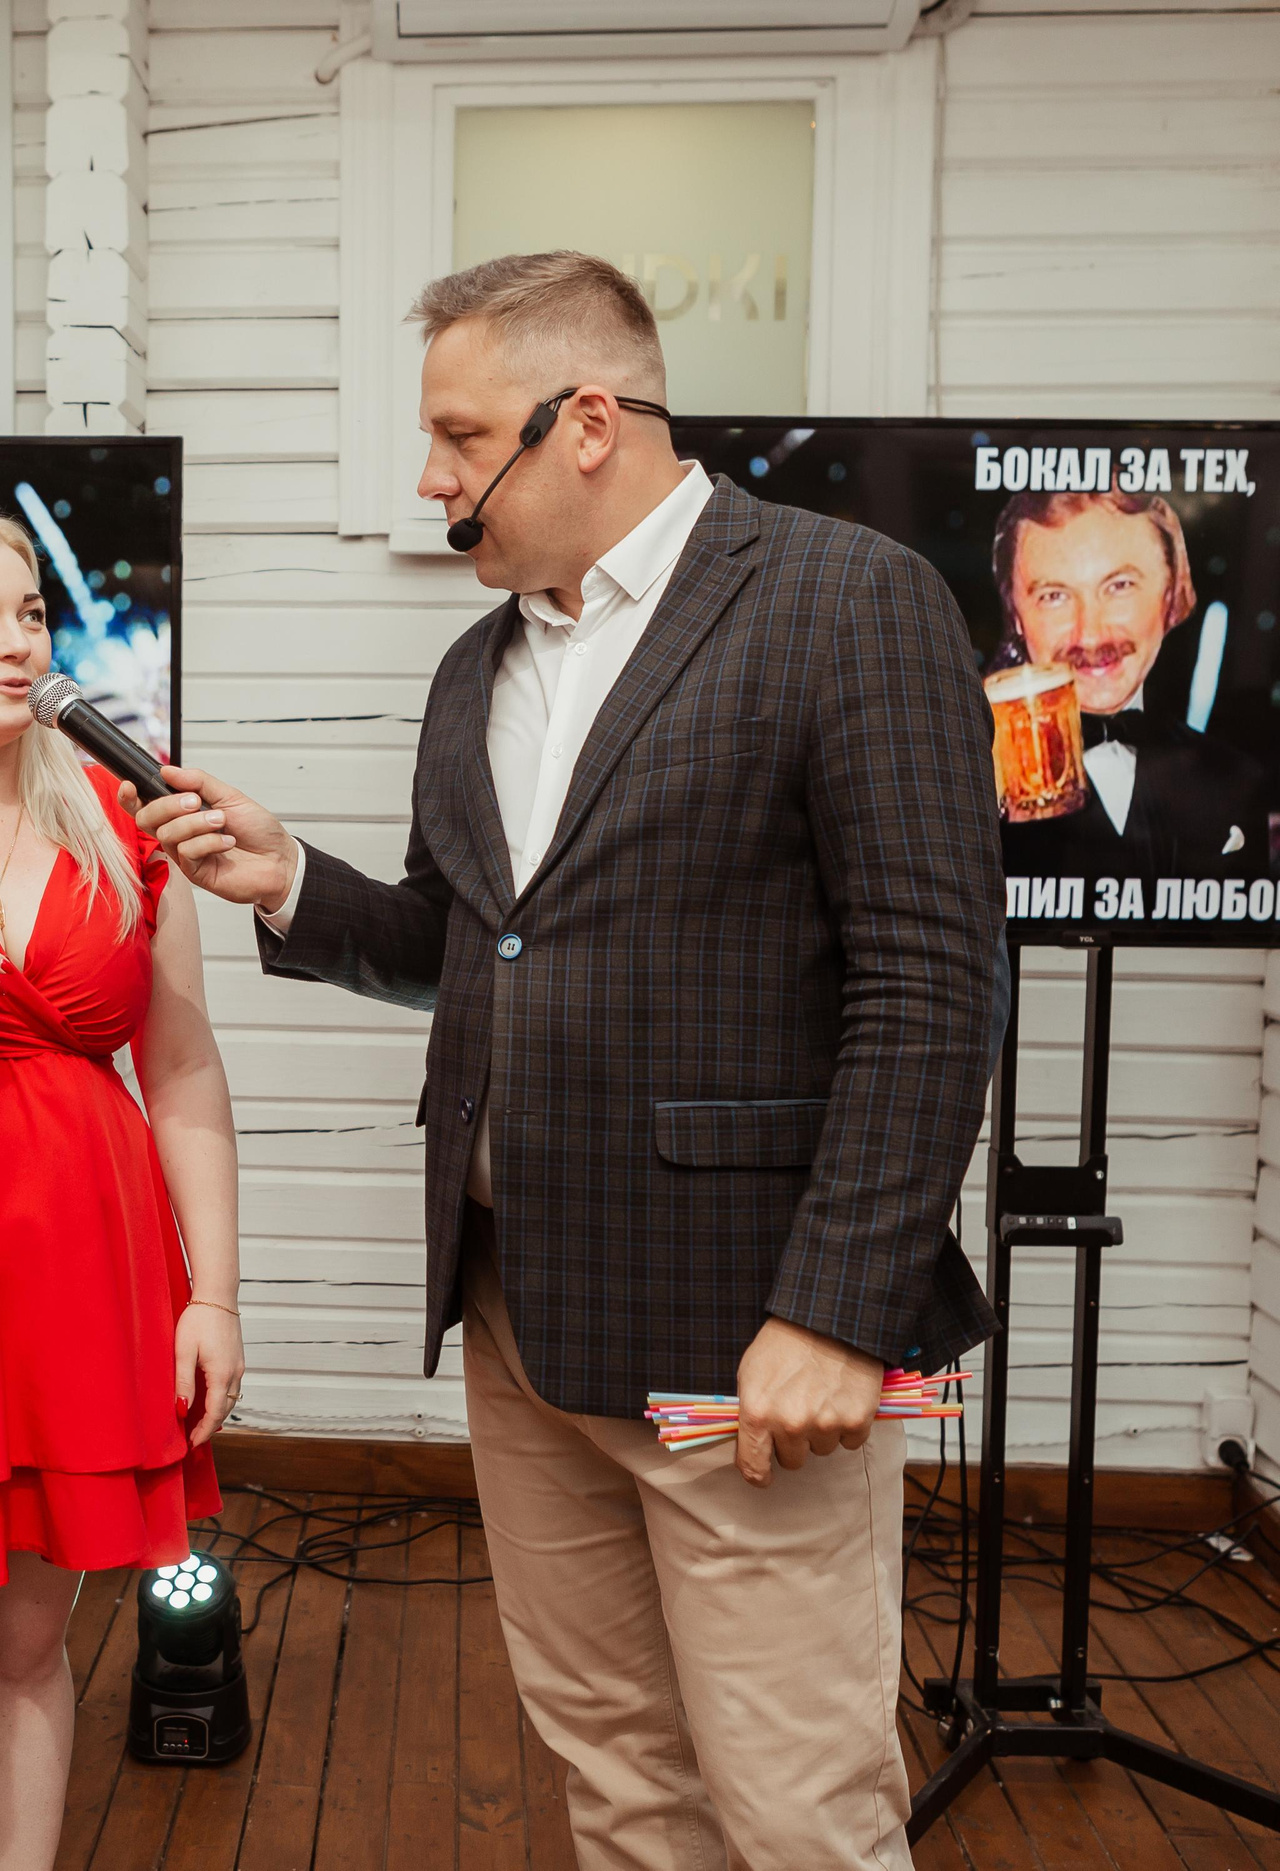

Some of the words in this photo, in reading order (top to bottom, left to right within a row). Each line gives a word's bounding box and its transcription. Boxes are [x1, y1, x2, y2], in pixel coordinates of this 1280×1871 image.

[975, 446, 1111, 492] БОКАЛ
[1119, 447, 1172, 492] ЗА
[1180, 448, 1256, 497] ТЕХ,
[1006, 877, 1085, 919] ПИЛ
[1094, 877, 1144, 920] ЗА
[1152, 878, 1280, 921] ЛЮБО
